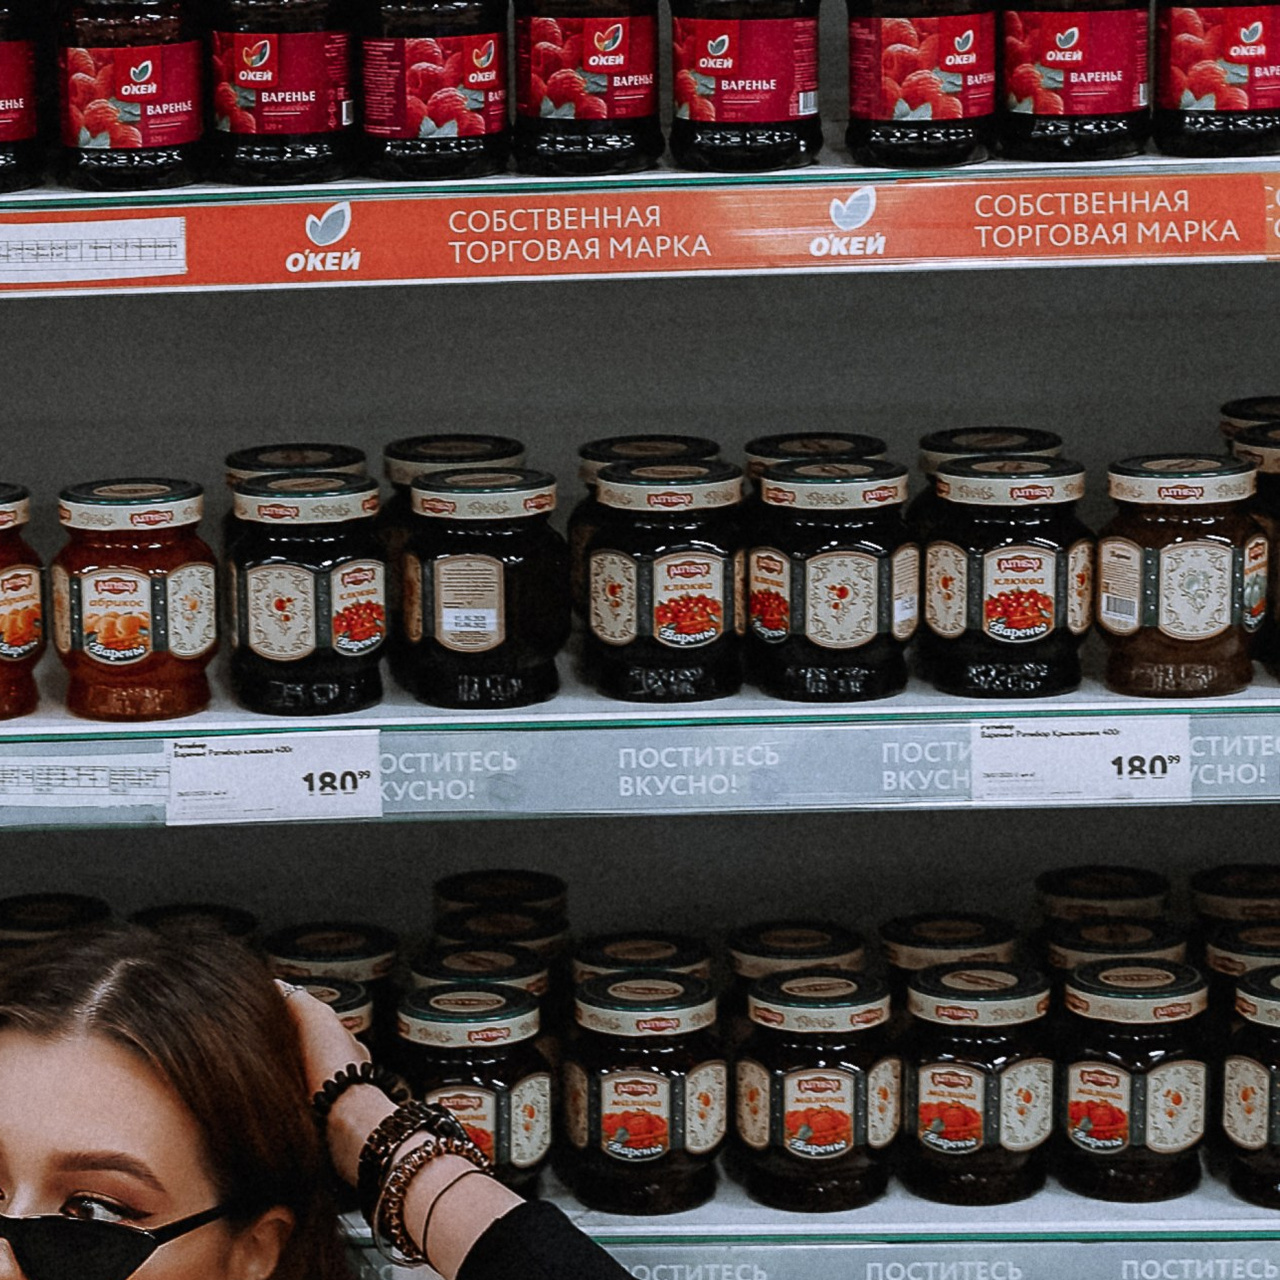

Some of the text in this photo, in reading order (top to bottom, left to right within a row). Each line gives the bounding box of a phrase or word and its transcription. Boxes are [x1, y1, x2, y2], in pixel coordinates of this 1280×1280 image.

[613, 74, 653, 87] ВАРЕНЬЕ
[1070, 71, 1123, 83] ВАРЕНЬЕ
[1254, 65, 1280, 78] ВАРЕ
[721, 79, 777, 91] ВАРЕНЬЕ
[261, 90, 315, 103] ВАРЕНЬЕ
[146, 100, 192, 116] ВАРЕНЬЕ
[974, 189, 1189, 218] СОБСТВЕННАЯ
[448, 205, 661, 233] СОБСТВЕННАЯ
[974, 219, 1240, 248] ТОРГОВАЯ МАРКА
[285, 247, 361, 272] О'КЕЙ
[448, 234, 712, 264] ТОРГОВАЯ МАРКА
[658, 627, 716, 646] Варенье
[989, 620, 1047, 639] Варенье
[383, 752, 518, 774] ОСТИТЕСЬ
[619, 743, 780, 768] ПОСТИТЕСЬ
[882, 741, 971, 763] ПОСТИ
[1111, 754, 1181, 778] 180 99
[302, 770, 371, 794] 180 99
[619, 773, 737, 796] ВКУСНО!
[882, 768, 970, 791] ВКУСН
[1122, 1258, 1279, 1280] ПОСТИТЕСЬ
